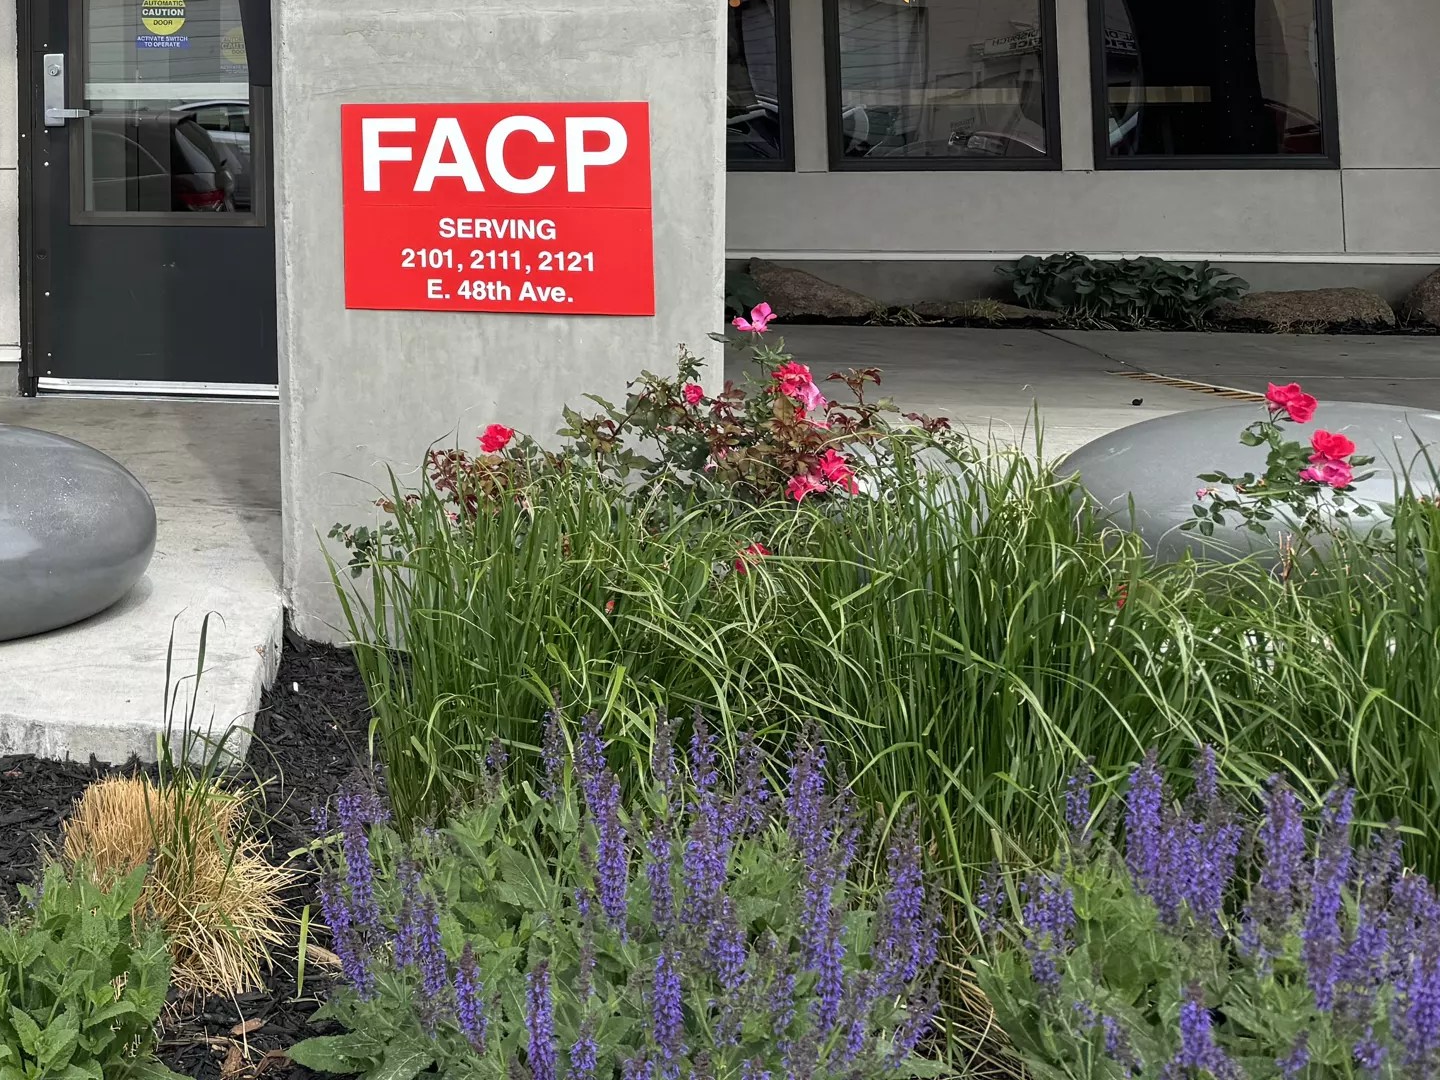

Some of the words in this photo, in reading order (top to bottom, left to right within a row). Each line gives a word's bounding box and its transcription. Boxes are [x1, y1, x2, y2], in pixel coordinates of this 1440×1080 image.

[142, 8, 184, 16] CAUTION
[361, 114, 629, 195] FACP
[438, 216, 557, 241] SERVING
[400, 247, 464, 273] 2101,
[469, 249, 532, 275] 2111,
[537, 250, 595, 272] 2121
[426, 278, 451, 300] E.
[457, 278, 512, 302] 48th
[518, 280, 575, 303] Ave.
